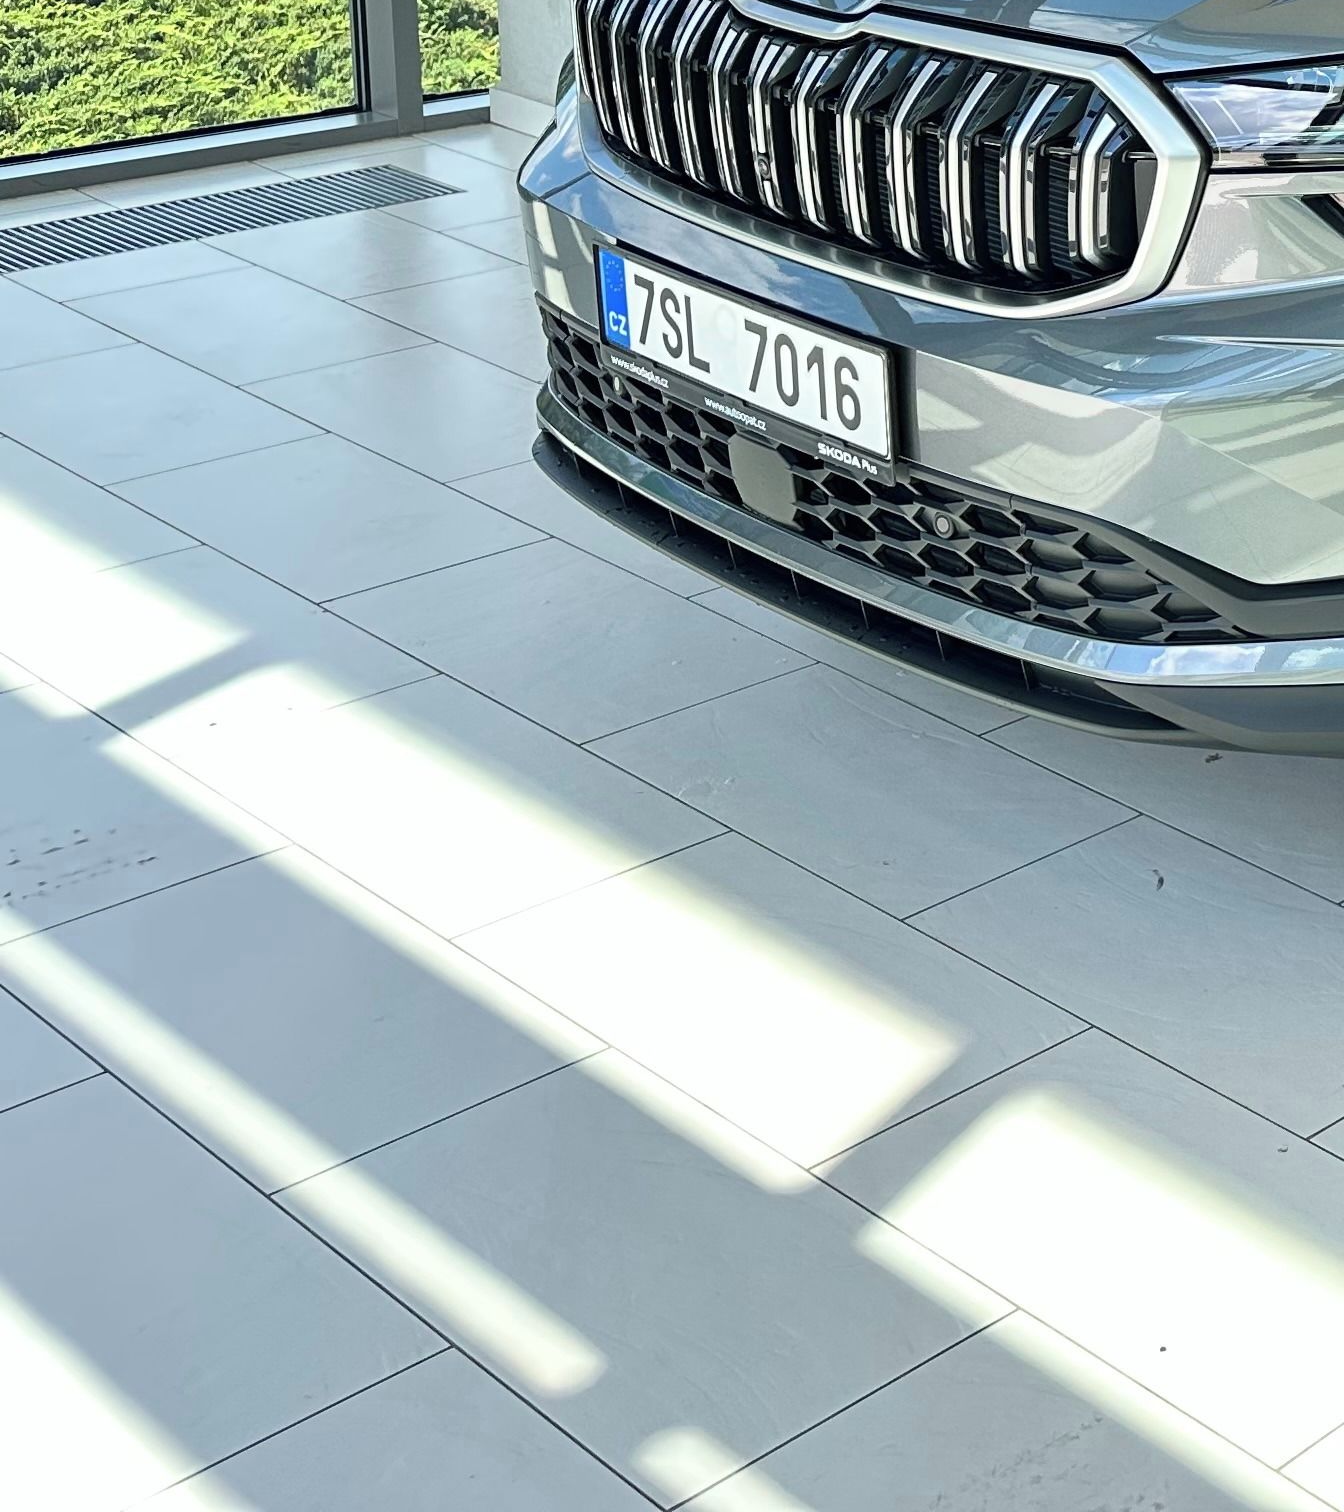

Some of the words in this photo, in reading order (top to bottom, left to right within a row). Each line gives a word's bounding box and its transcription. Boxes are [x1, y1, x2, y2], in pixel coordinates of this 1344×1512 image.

[608, 309, 628, 337] CZ
[634, 274, 711, 374] 7SL
[744, 318, 862, 431] 7016
[861, 458, 878, 475] Plus
